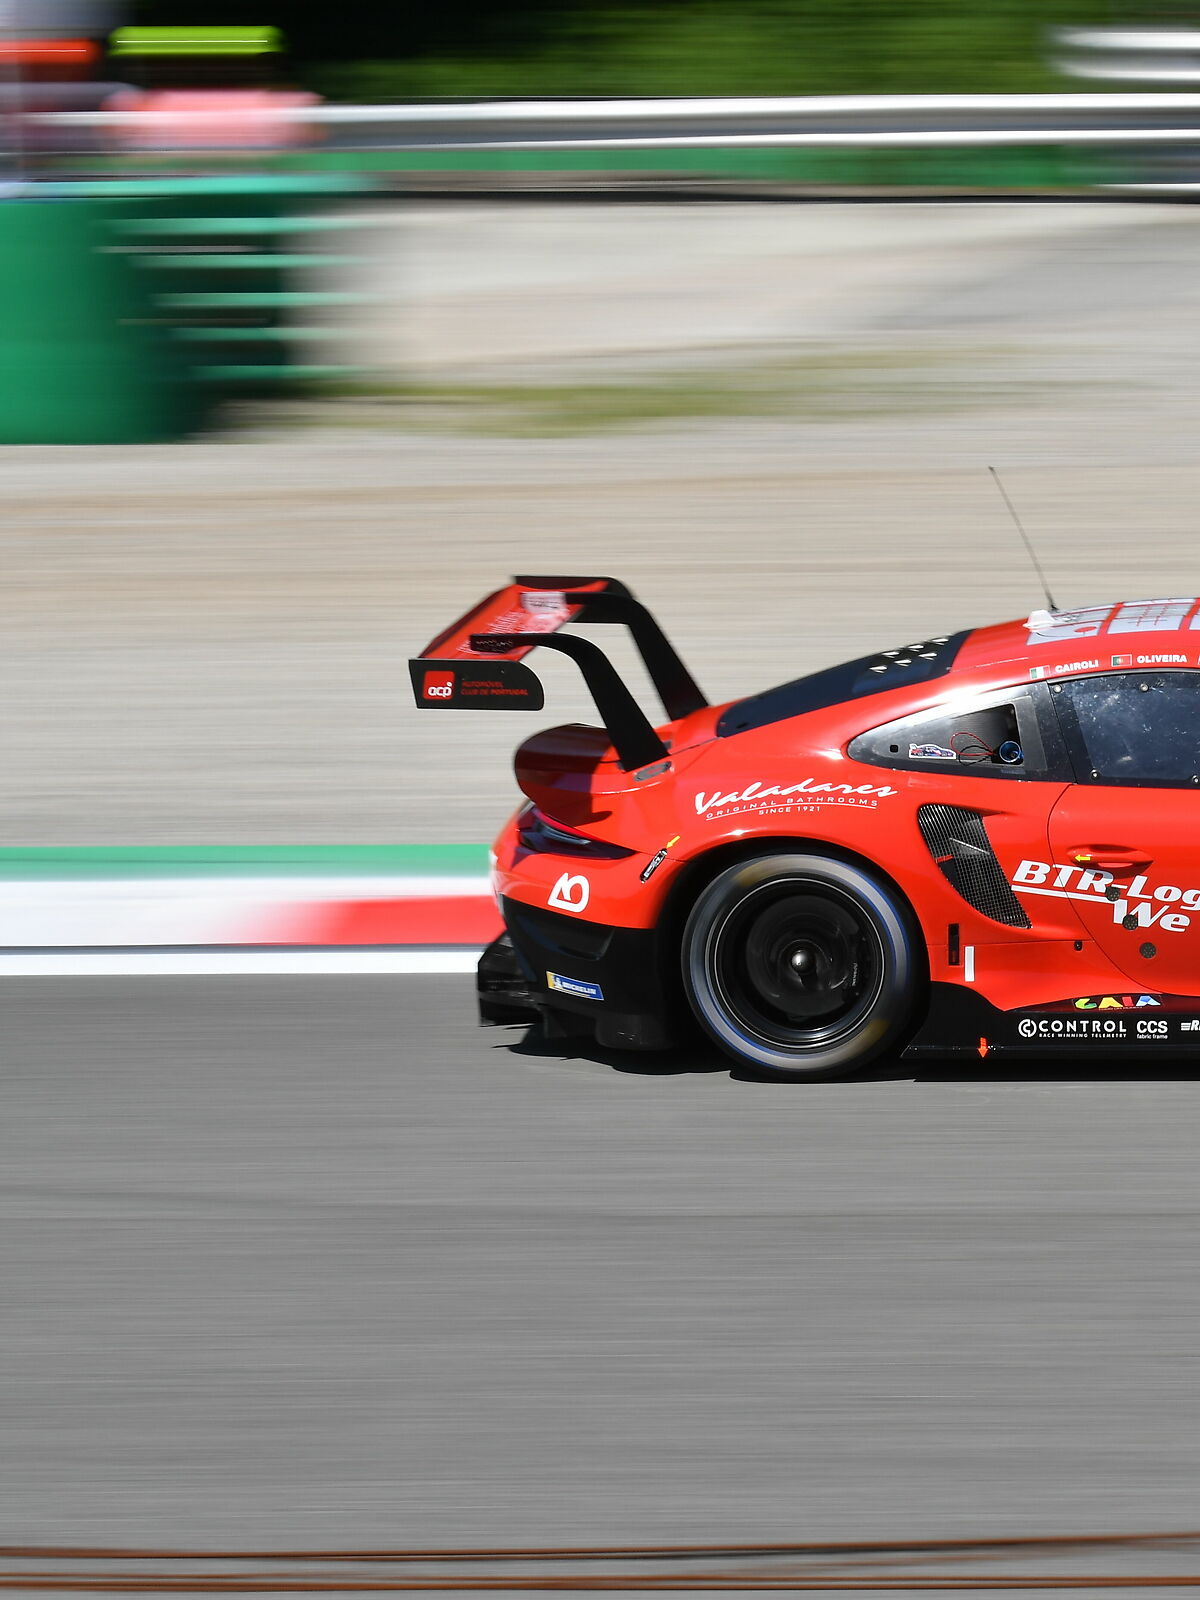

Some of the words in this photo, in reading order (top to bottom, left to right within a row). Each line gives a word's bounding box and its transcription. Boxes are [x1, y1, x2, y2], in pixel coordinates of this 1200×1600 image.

[1137, 654, 1187, 664] OLIVEIRA
[1054, 660, 1099, 673] CAIROLI
[694, 777, 898, 815] Valadares
[706, 801, 777, 819] ORIGINAL
[786, 796, 878, 807] BATHROOMS
[758, 806, 791, 815] SINCE
[1112, 899, 1191, 932] We
[1038, 1020, 1127, 1033] CONTROL
[1136, 1020, 1168, 1033] CCS
